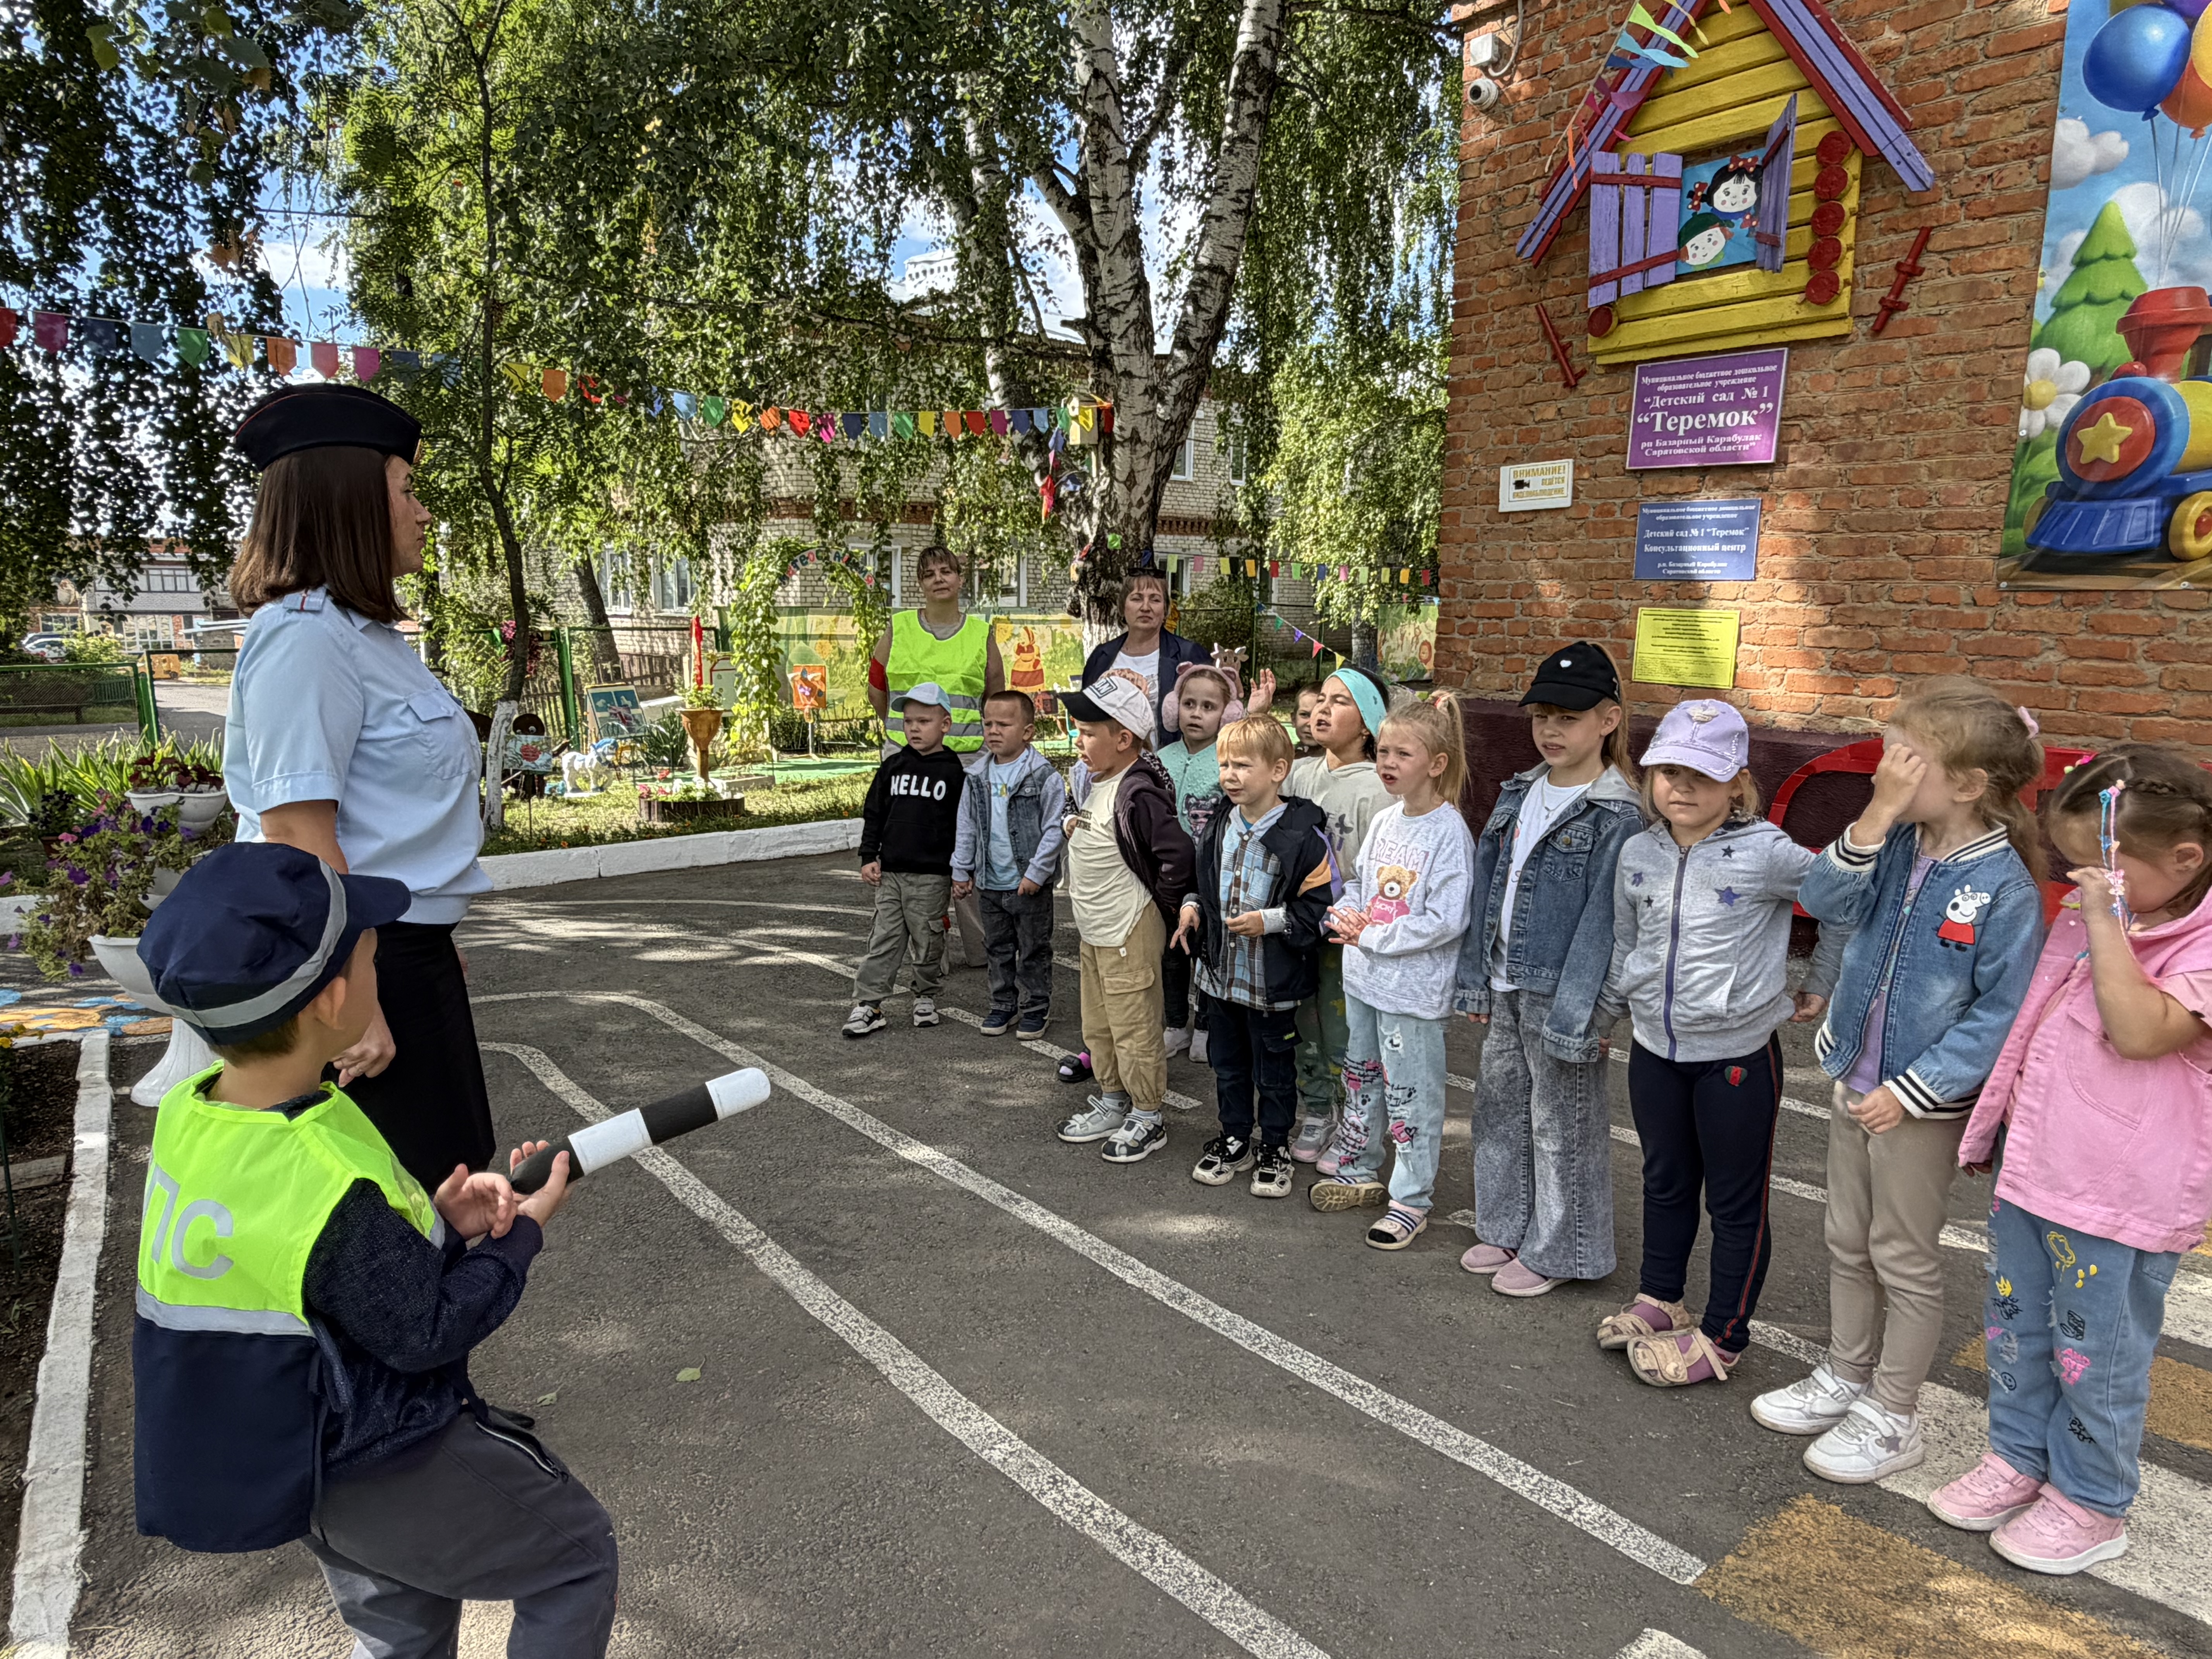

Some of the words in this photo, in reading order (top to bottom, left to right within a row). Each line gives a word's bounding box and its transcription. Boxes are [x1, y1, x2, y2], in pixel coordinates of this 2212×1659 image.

[1712, 392, 1734, 402] сад
[1762, 386, 1769, 398] 1
[1656, 436, 1704, 448] Базарный
[1707, 434, 1762, 445] Карабулак
[1645, 445, 1707, 457] Саратовской
[1513, 465, 1565, 479] ВНИМАНИЕ!
[1643, 529, 1674, 538] Детский
[1701, 528, 1705, 537] 1
[1644, 543, 1720, 554] Консультационный
[1721, 544, 1746, 553] центр
[891, 774, 946, 800] HELLO
